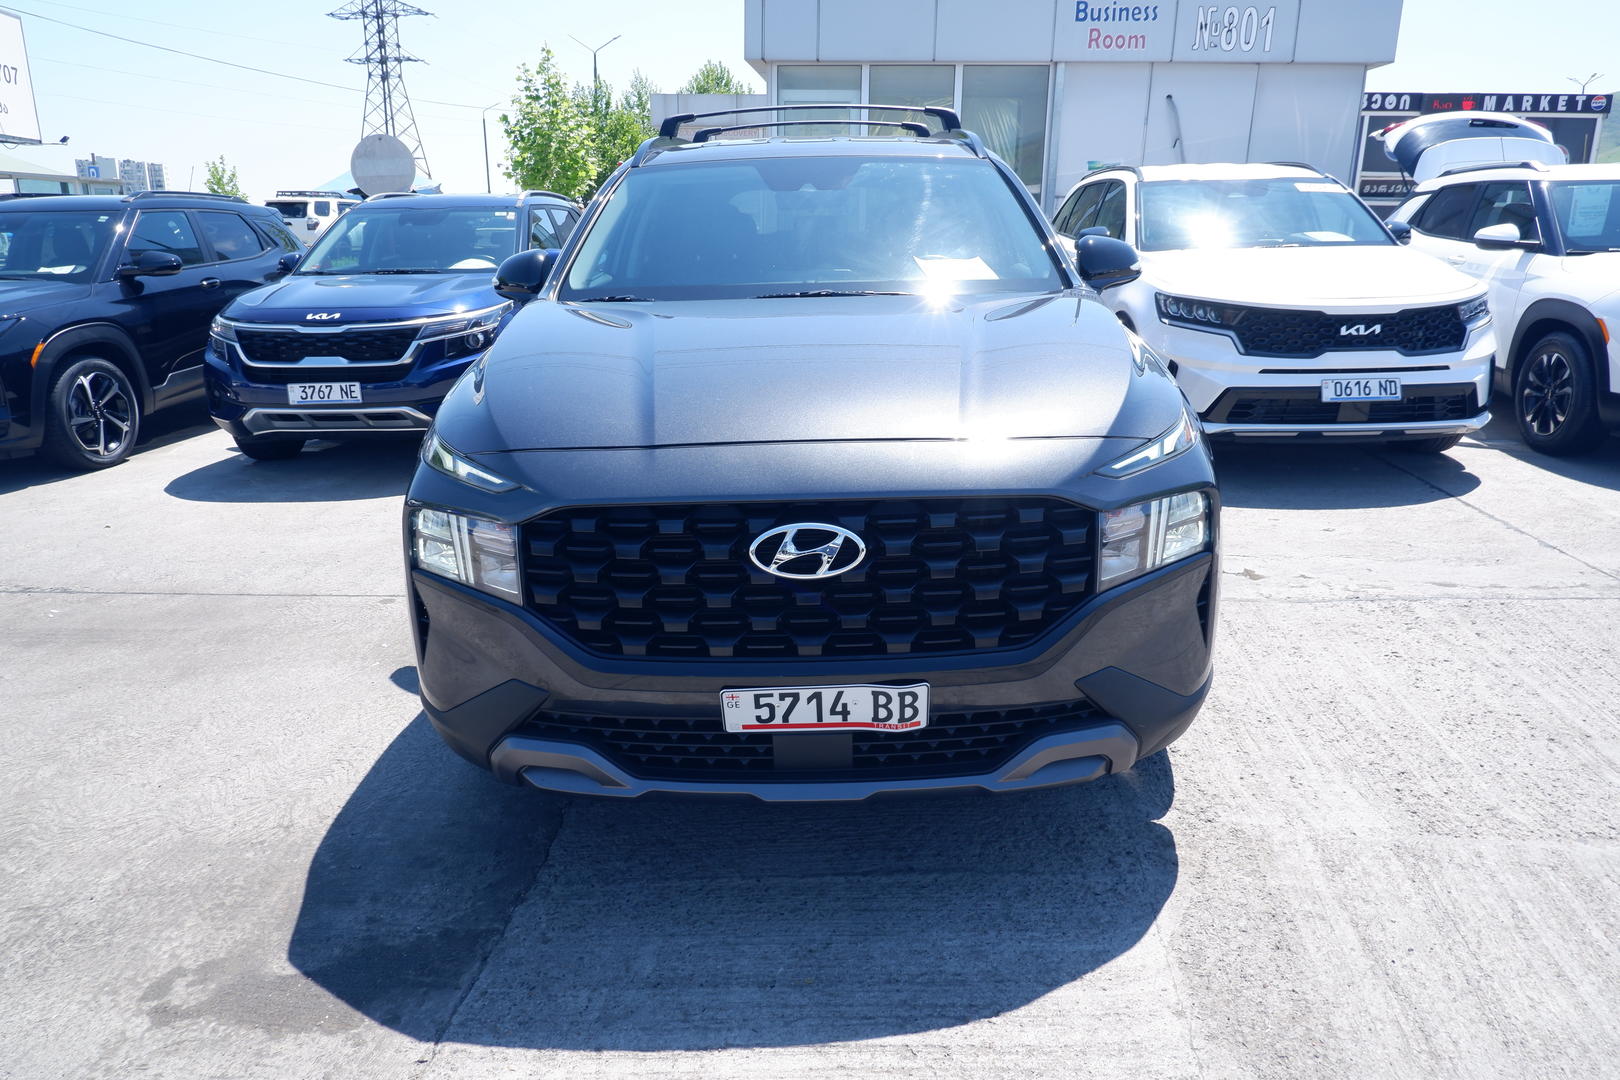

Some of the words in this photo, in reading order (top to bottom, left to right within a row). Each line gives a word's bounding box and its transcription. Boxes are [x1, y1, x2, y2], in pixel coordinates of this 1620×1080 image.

[1074, 0, 1158, 22] Business
[1088, 28, 1146, 49] Room
[0, 63, 17, 85] 07
[1483, 95, 1587, 111] MARKET
[306, 312, 341, 320] KIA
[1340, 324, 1381, 336] KIA
[299, 385, 333, 400] 3767
[339, 384, 358, 399] NE
[1334, 381, 1371, 397] 0616
[1379, 379, 1398, 396] ND
[726, 701, 741, 709] GE
[753, 691, 851, 723] 5714
[871, 690, 920, 724] BB
[873, 721, 912, 730] TRANSIT
